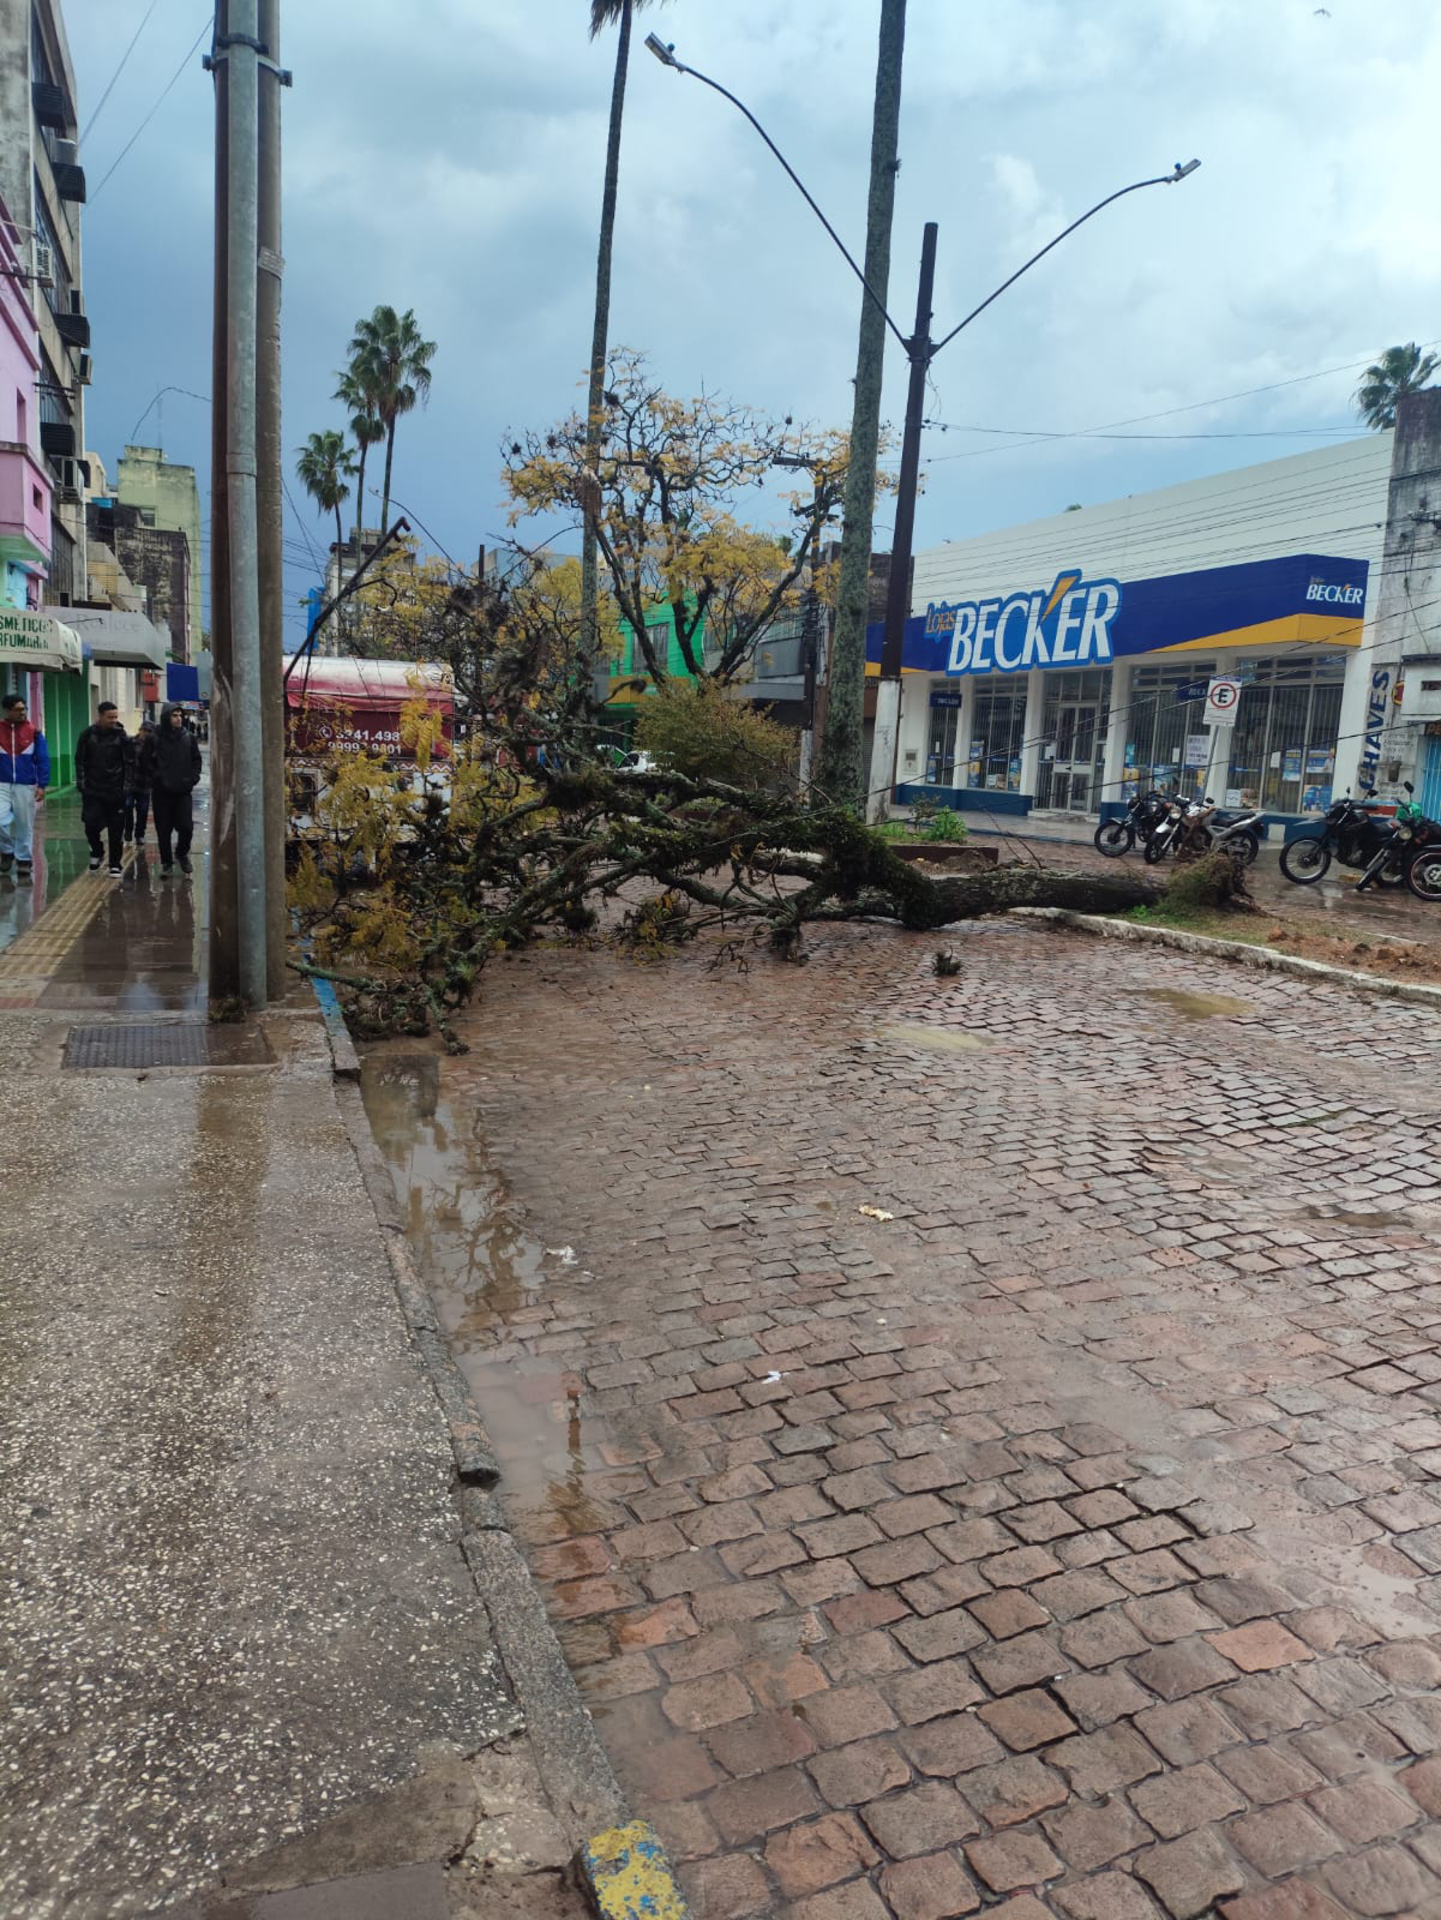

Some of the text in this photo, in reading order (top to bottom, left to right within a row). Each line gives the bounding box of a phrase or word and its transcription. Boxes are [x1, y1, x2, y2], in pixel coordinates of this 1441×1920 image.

[948, 576, 1119, 670] BECKER
[1306, 583, 1363, 605] BECKER
[1218, 688, 1229, 704] E
[1359, 670, 1389, 790] CHAVES
